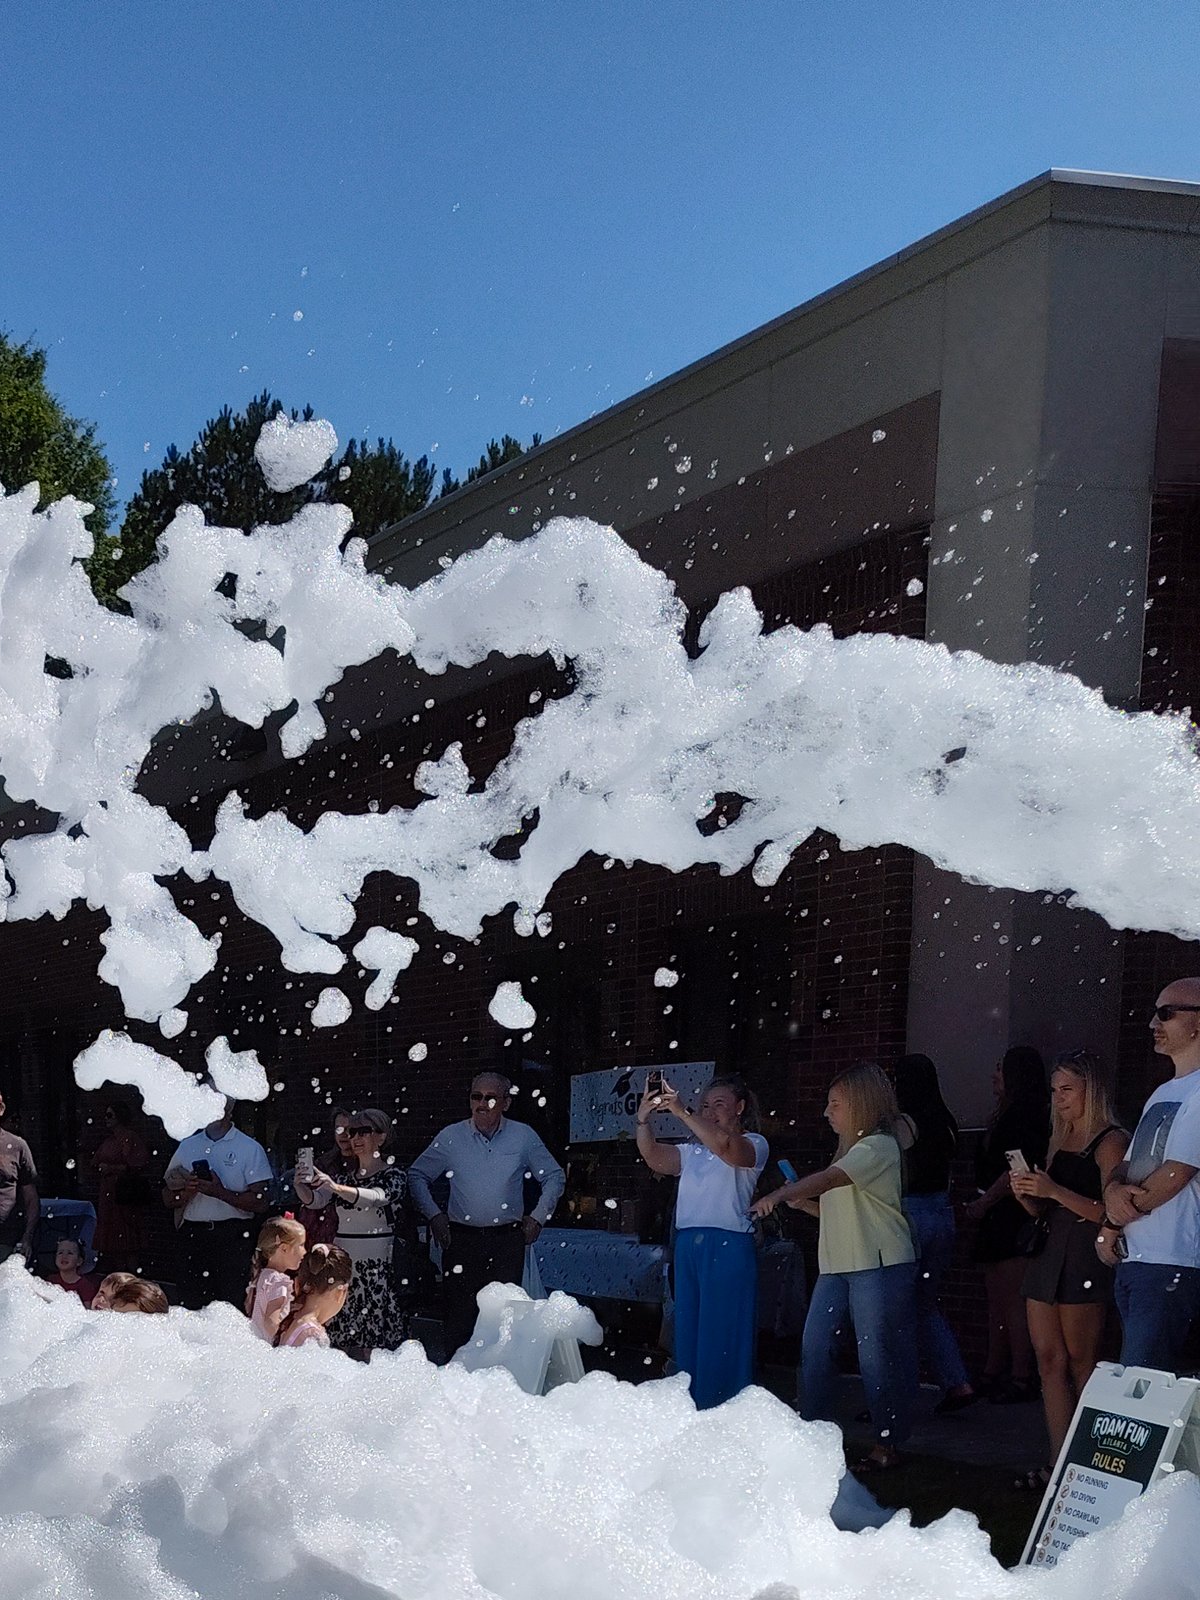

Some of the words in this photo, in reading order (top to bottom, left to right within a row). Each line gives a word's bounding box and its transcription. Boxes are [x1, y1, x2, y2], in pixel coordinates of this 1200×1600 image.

[1093, 1416, 1127, 1438] FOAM
[1123, 1421, 1149, 1447] FUN
[1102, 1437, 1128, 1450] ATLANTA
[1091, 1452, 1126, 1474] RULES
[1077, 1473, 1085, 1483] NO
[1085, 1476, 1109, 1490] RUNNING
[1070, 1490, 1078, 1499] NO
[1078, 1492, 1096, 1504] DIVING
[1064, 1506, 1072, 1516] NO
[1072, 1509, 1100, 1525] CRAWLING
[1058, 1523, 1067, 1532] NO
[1052, 1539, 1060, 1548] NO
